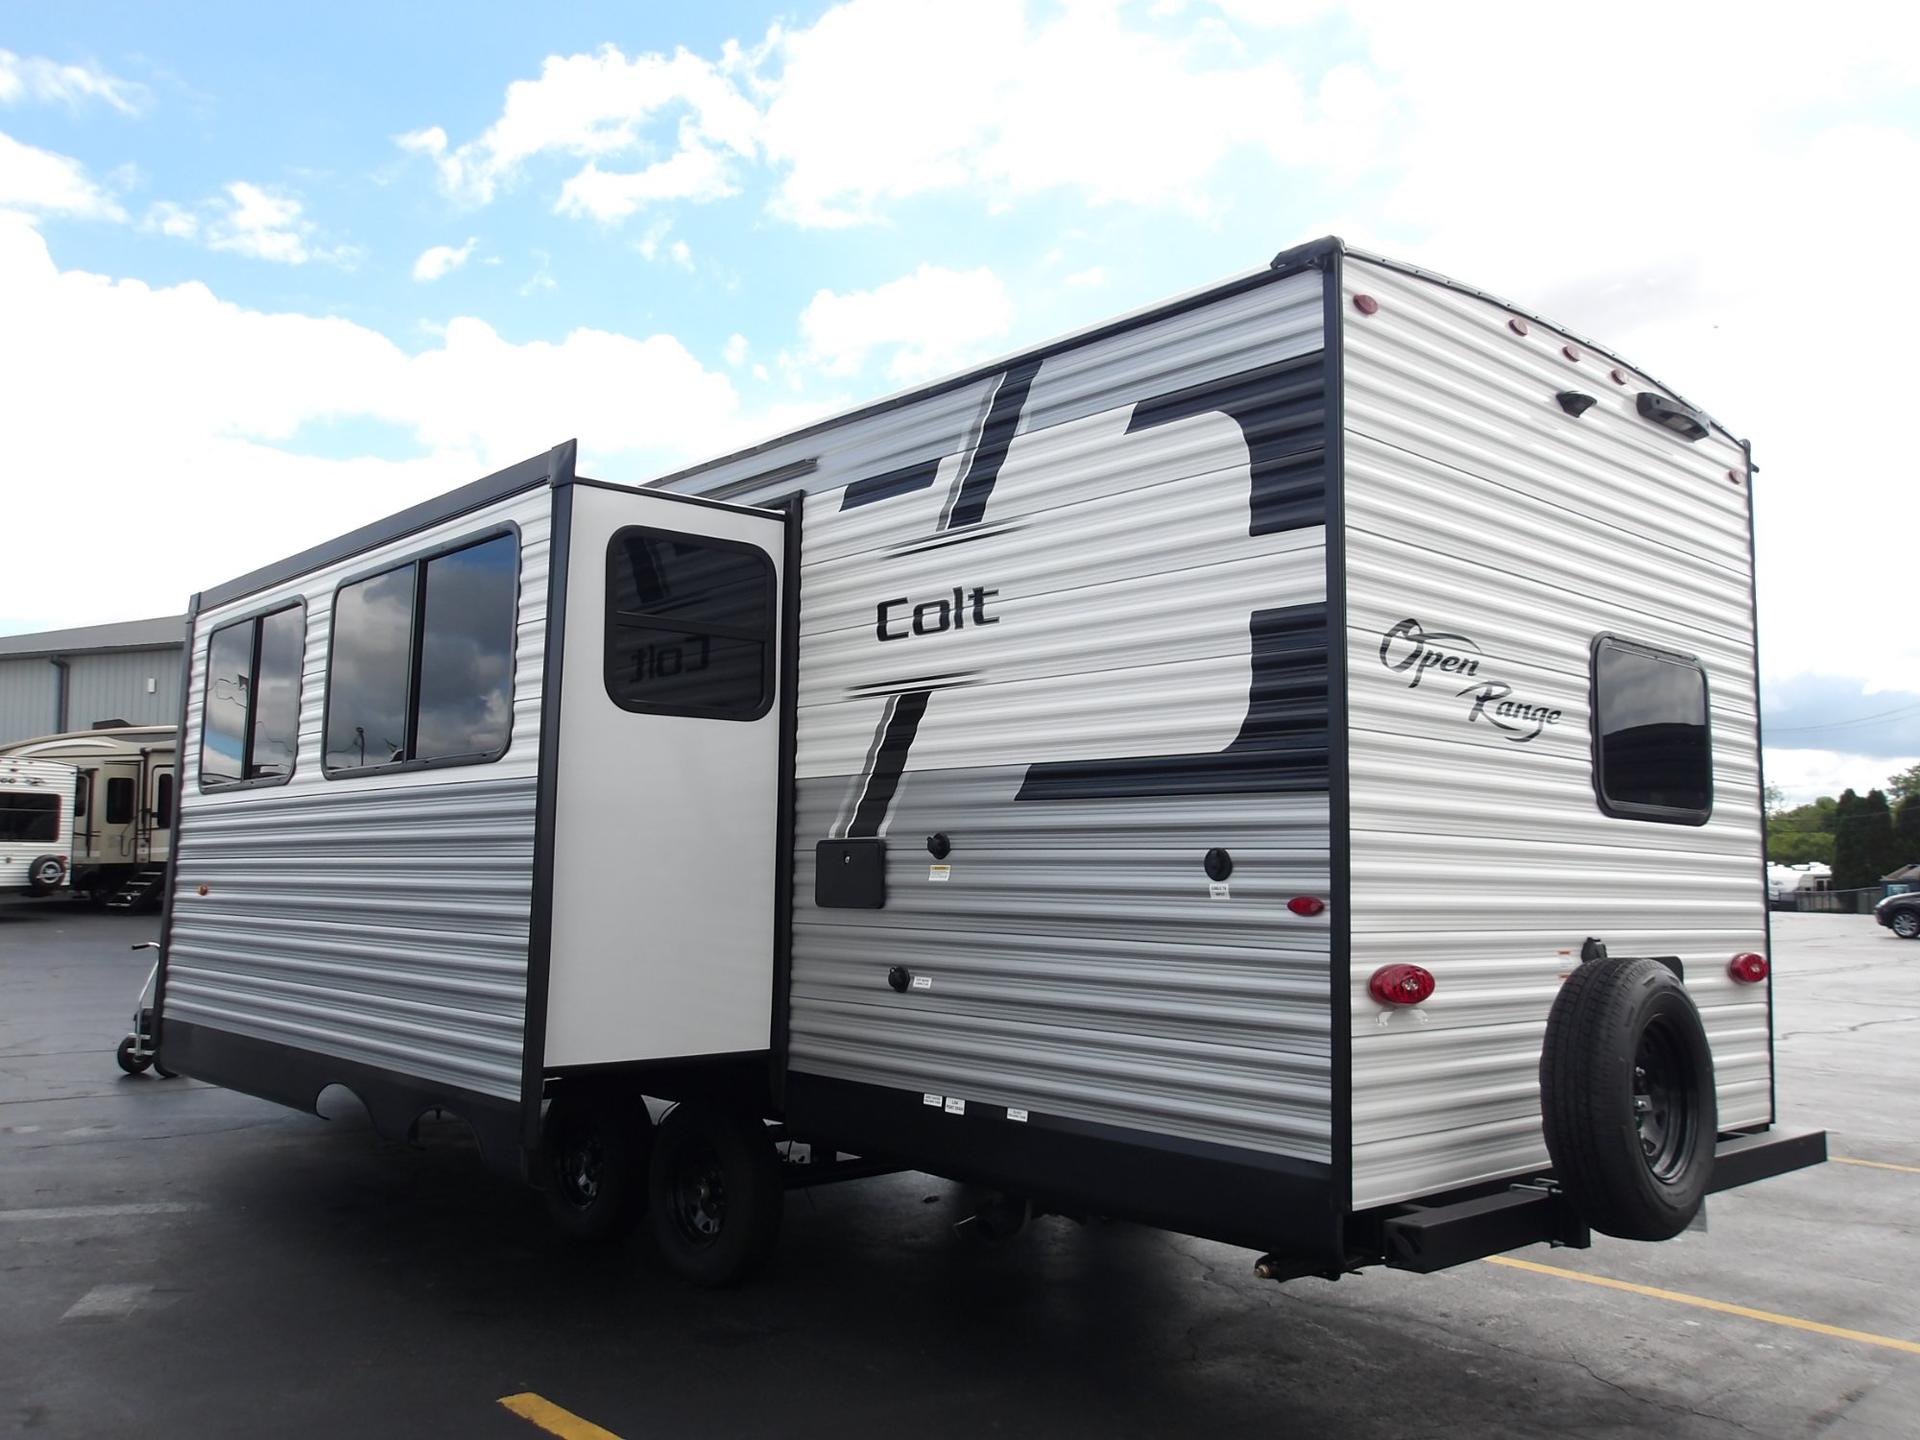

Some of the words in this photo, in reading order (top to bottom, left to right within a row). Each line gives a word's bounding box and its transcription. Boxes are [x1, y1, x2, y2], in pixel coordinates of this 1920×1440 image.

[877, 586, 1000, 642] Colt
[1379, 618, 1482, 688] Open
[1455, 681, 1562, 742] Range
